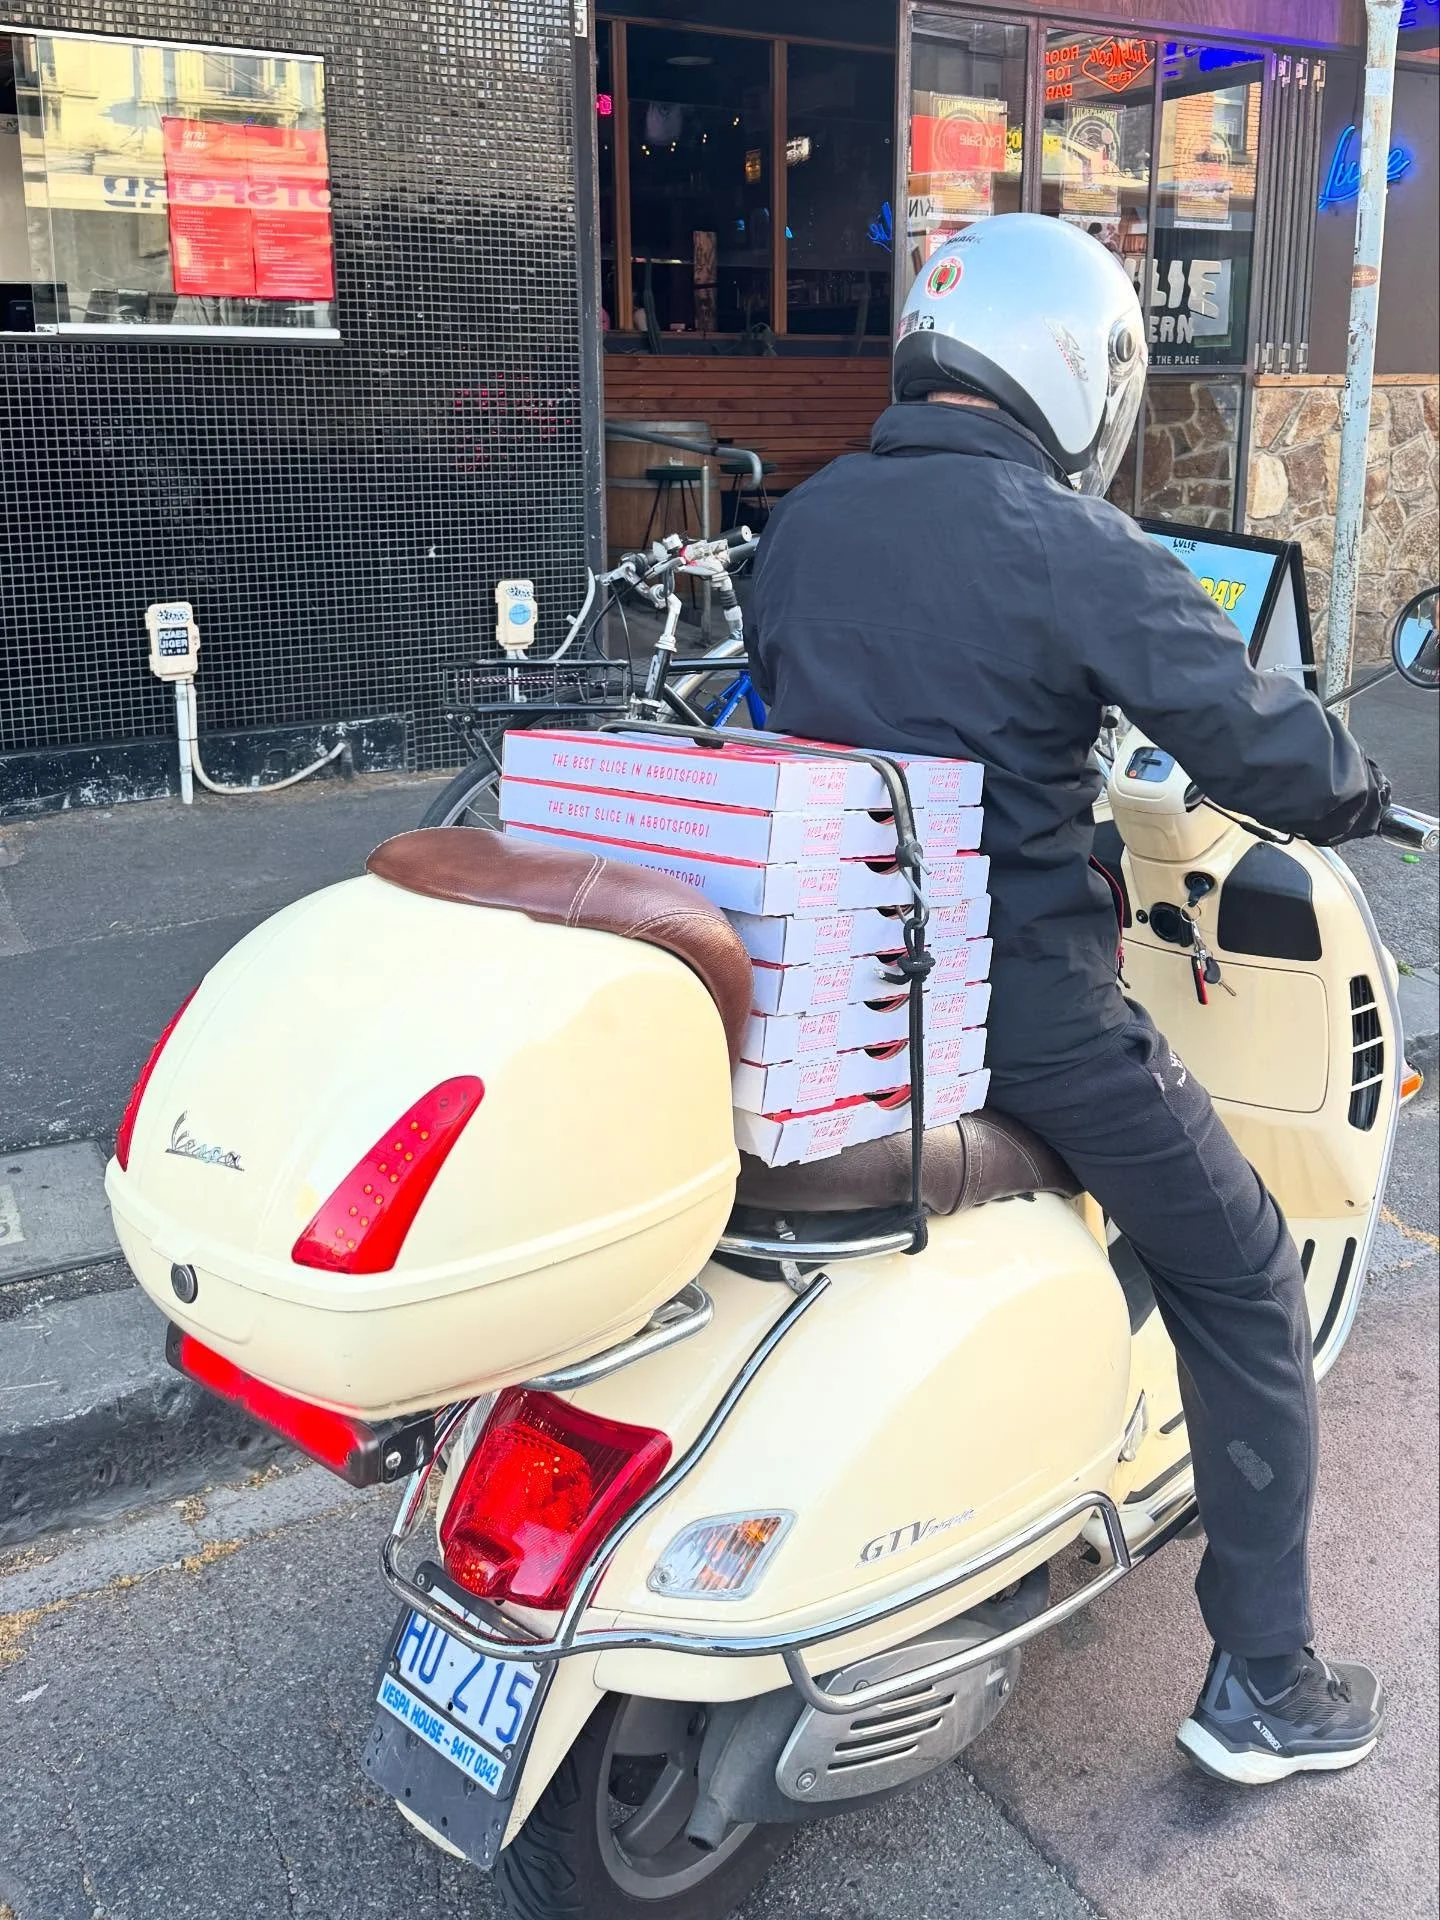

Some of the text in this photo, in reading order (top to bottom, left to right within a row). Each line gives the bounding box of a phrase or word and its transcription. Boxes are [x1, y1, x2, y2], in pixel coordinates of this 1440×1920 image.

[1148, 315, 1193, 344] ERN
[1156, 355, 1171, 365] THE
[1174, 355, 1200, 365] PLACE
[1200, 577, 1247, 610] DAY
[552, 753, 719, 787] THE BEST SLICE IN ABBOTSFORD!
[547, 800, 711, 838] THE BEST SLICE IN ABBOTSFORD!
[382, 1680, 412, 1719] VESPA
[410, 1704, 445, 1743] HOUSE
[450, 1736, 476, 1768] 9417
[474, 1753, 499, 1787] 0342
